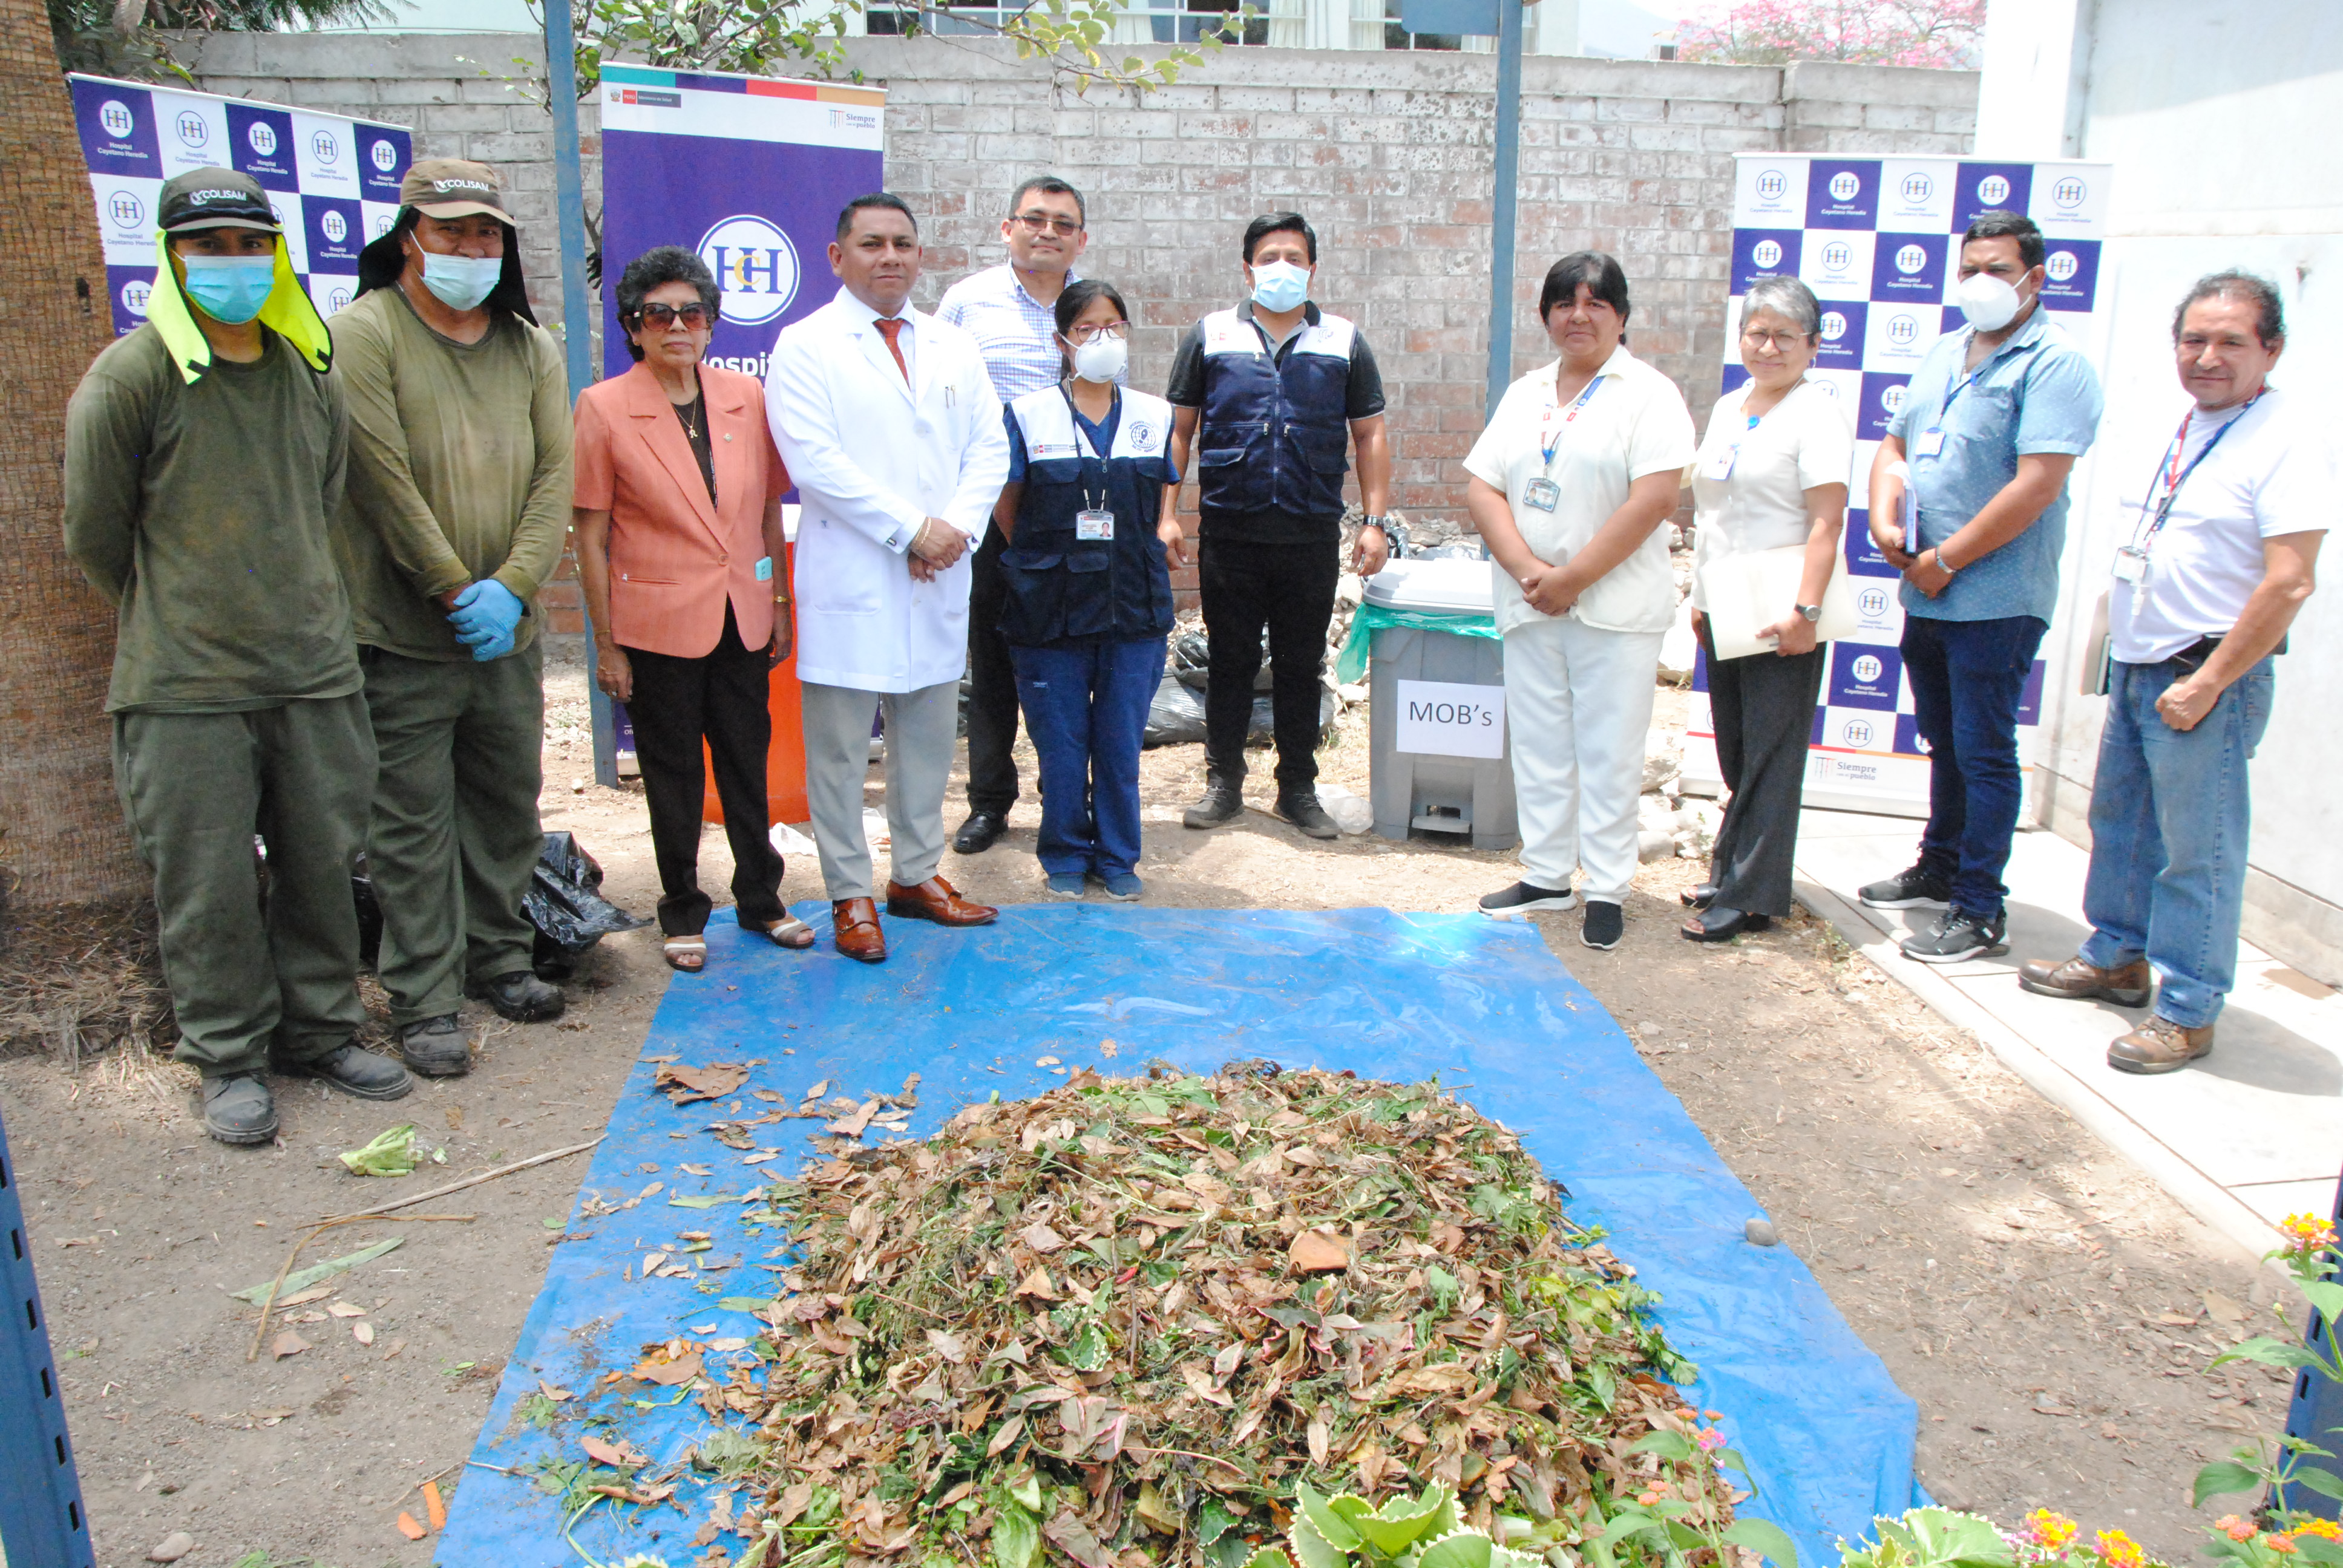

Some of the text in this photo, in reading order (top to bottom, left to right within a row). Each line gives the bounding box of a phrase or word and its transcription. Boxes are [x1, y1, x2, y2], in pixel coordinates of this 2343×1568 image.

[846, 114, 875, 123] Siempre
[97, 147, 125, 157] Cayetano
[110, 142, 133, 151] Hospital
[257, 159, 277, 168] Hospital
[447, 179, 489, 192] COLISAM
[202, 189, 247, 201] COLISAM
[1409, 701, 1493, 727] MOB's
[1837, 762, 1876, 774] Siempre
